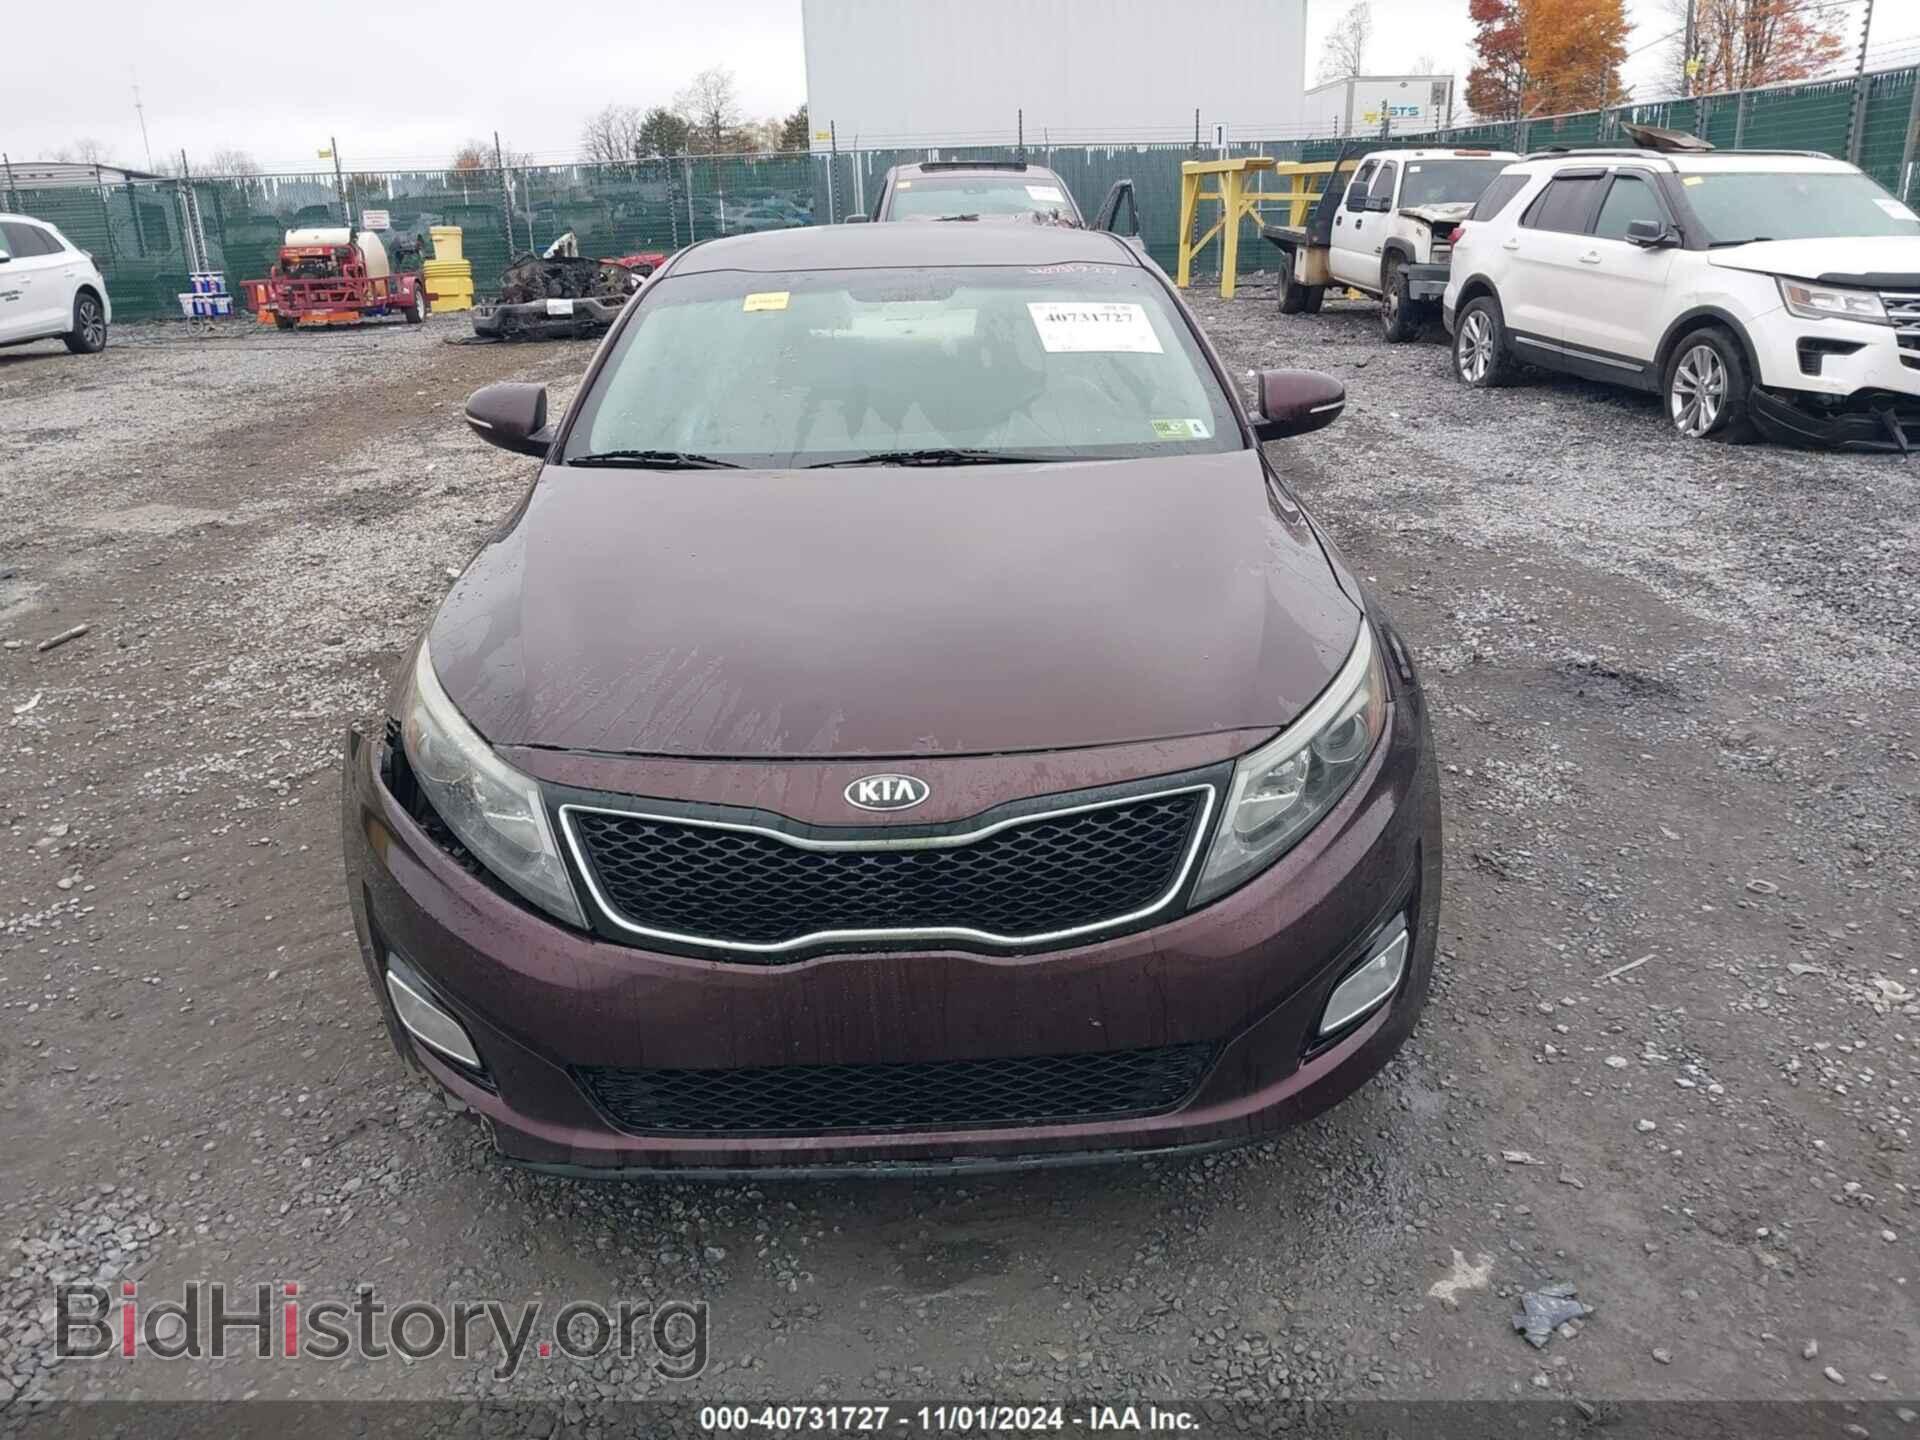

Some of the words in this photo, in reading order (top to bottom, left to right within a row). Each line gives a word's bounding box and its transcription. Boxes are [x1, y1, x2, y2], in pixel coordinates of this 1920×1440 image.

[1216, 126, 1222, 145] 1
[1044, 312, 1133, 323] 40731727
[859, 779, 916, 802] KIA
